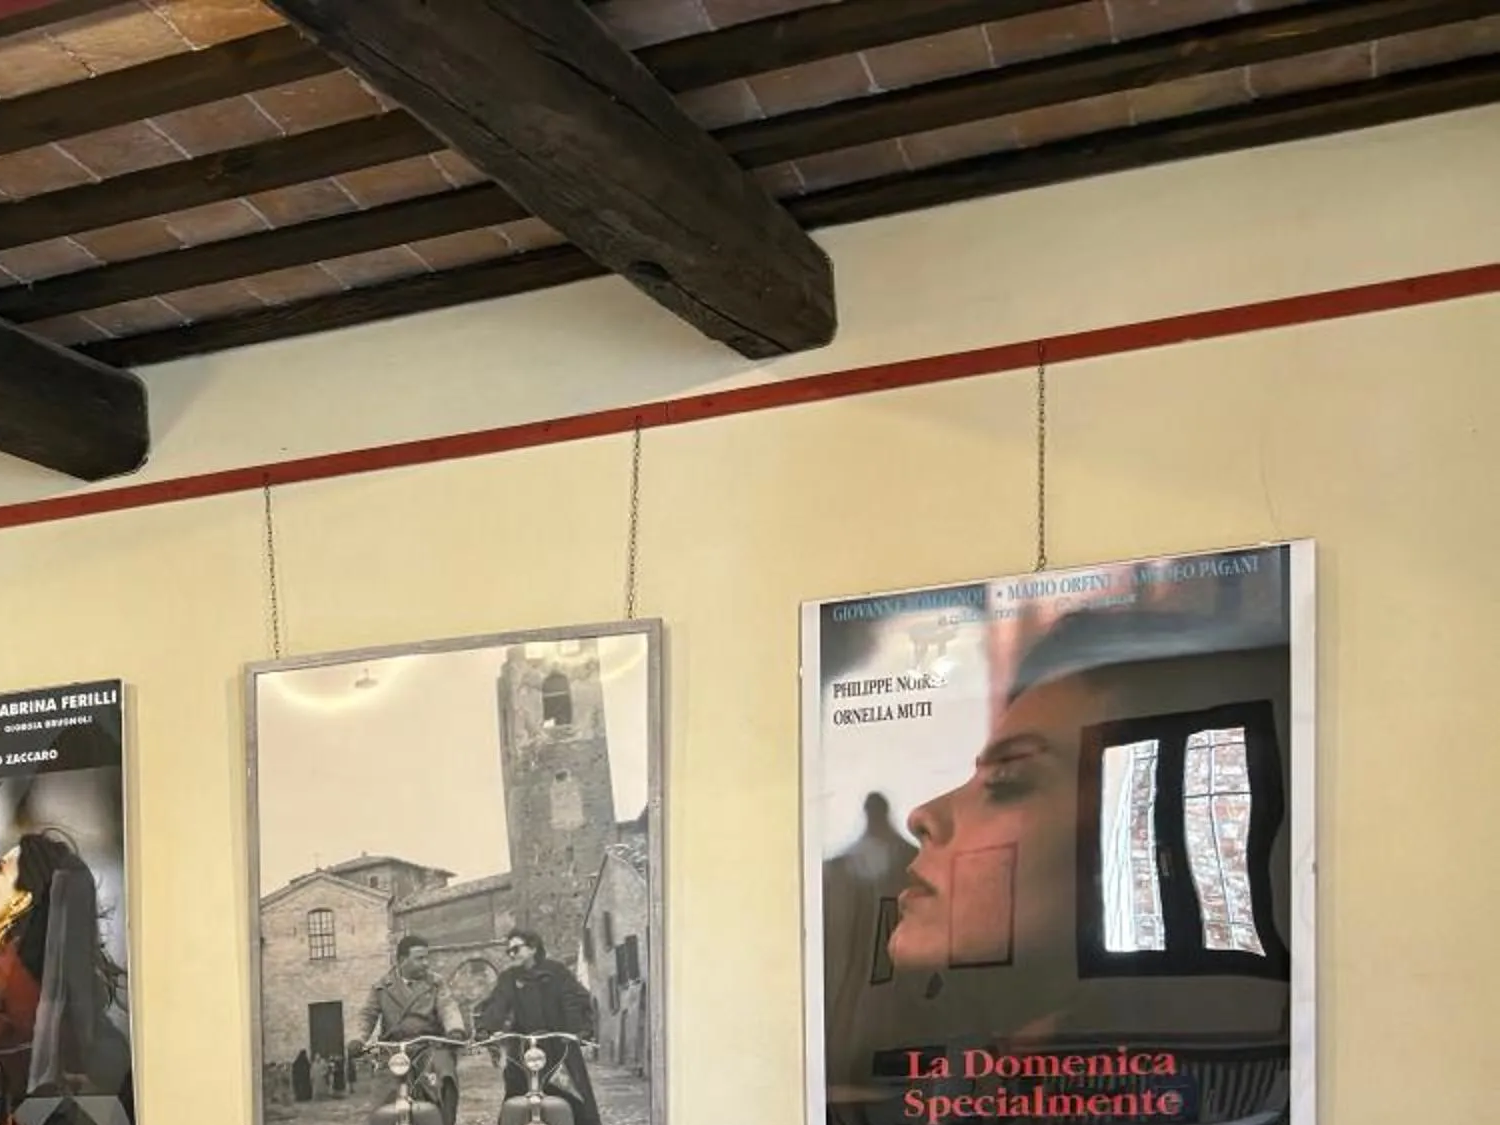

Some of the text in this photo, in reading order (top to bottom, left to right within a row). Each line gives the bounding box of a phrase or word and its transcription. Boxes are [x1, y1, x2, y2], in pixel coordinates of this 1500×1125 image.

[1007, 581, 1058, 600] MARIO
[1200, 555, 1260, 577] PAGANI
[833, 673, 947, 699] PHILIPPE NOIR
[61, 689, 117, 710] FERILLI
[833, 701, 932, 725] ORNELLA MUTI
[5, 749, 59, 766] ZACCARO
[904, 1046, 1177, 1079] La Domenica
